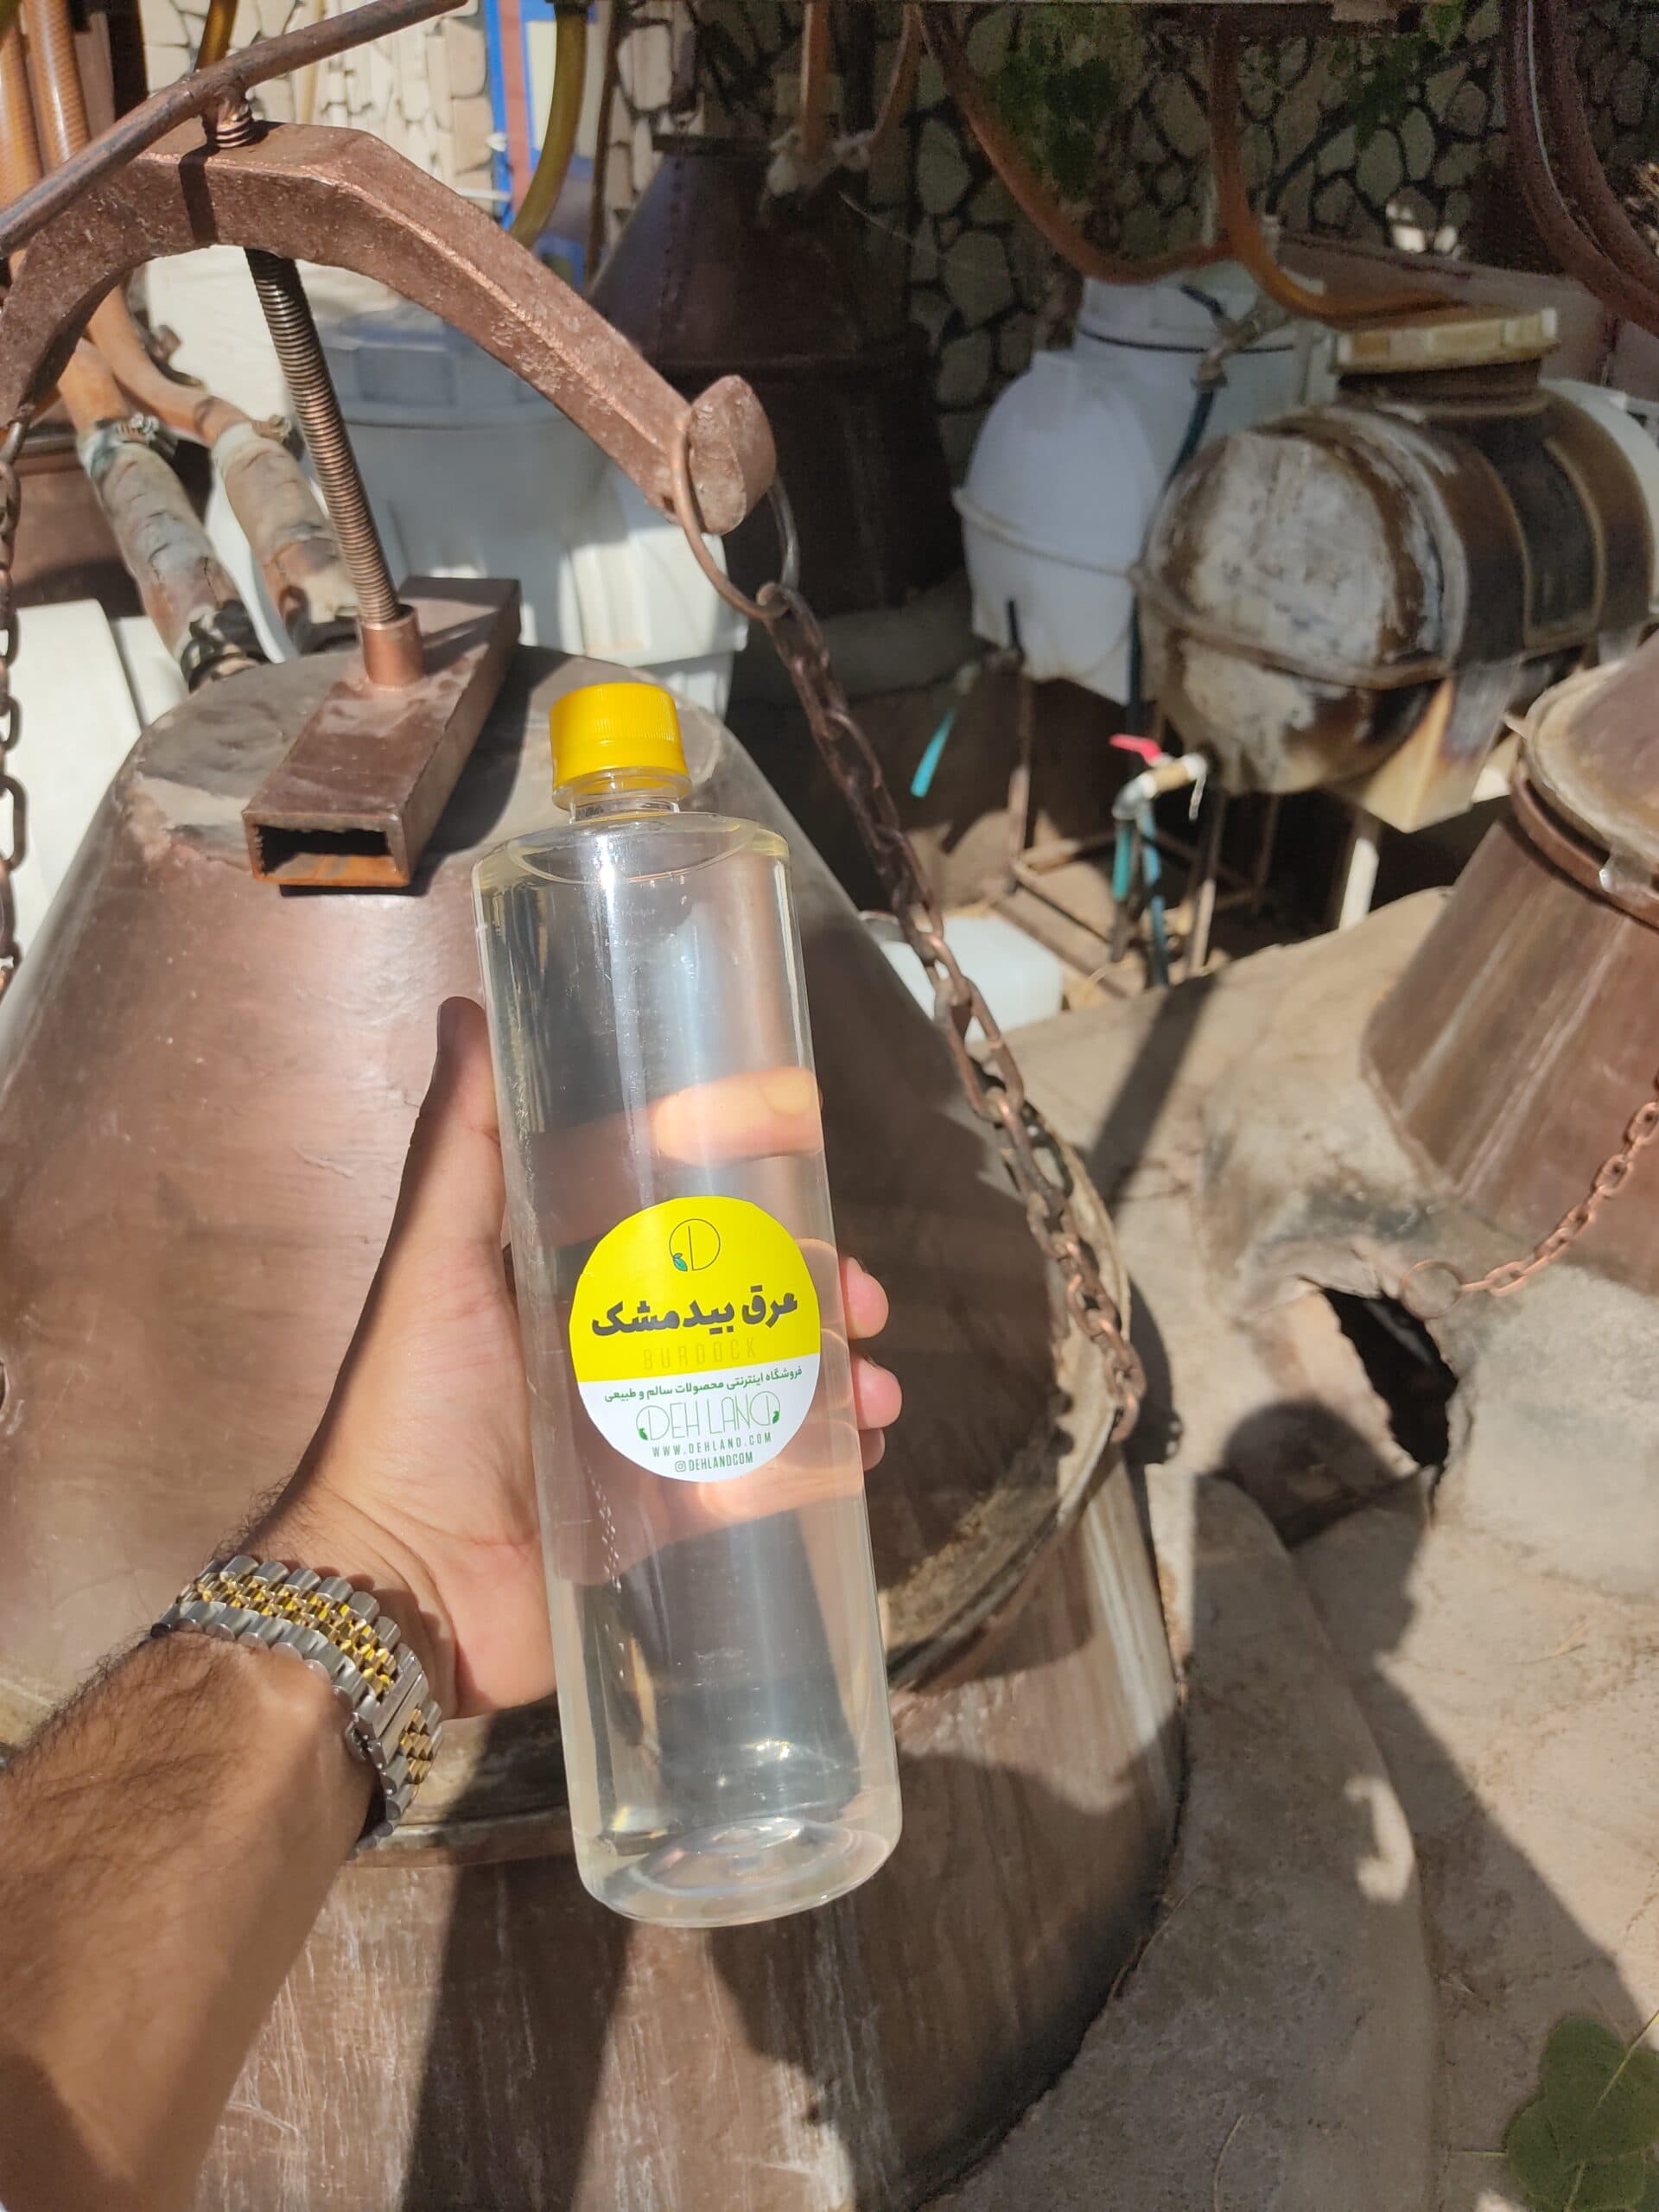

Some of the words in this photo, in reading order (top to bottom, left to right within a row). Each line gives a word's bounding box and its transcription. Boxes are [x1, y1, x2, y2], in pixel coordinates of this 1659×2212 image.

[741, 1284, 798, 1328] عرق
[643, 1336, 757, 1371] BURDOCK
[726, 1372, 764, 1390] اینترنتی
[766, 1365, 803, 1382] فروشگاه
[604, 1388, 636, 1402] طبیعی
[639, 1390, 645, 1401] و
[646, 1385, 672, 1400] سالم
[675, 1382, 724, 1395] محصولات
[652, 1431, 772, 1458] WWW.DEHLAND.COM
